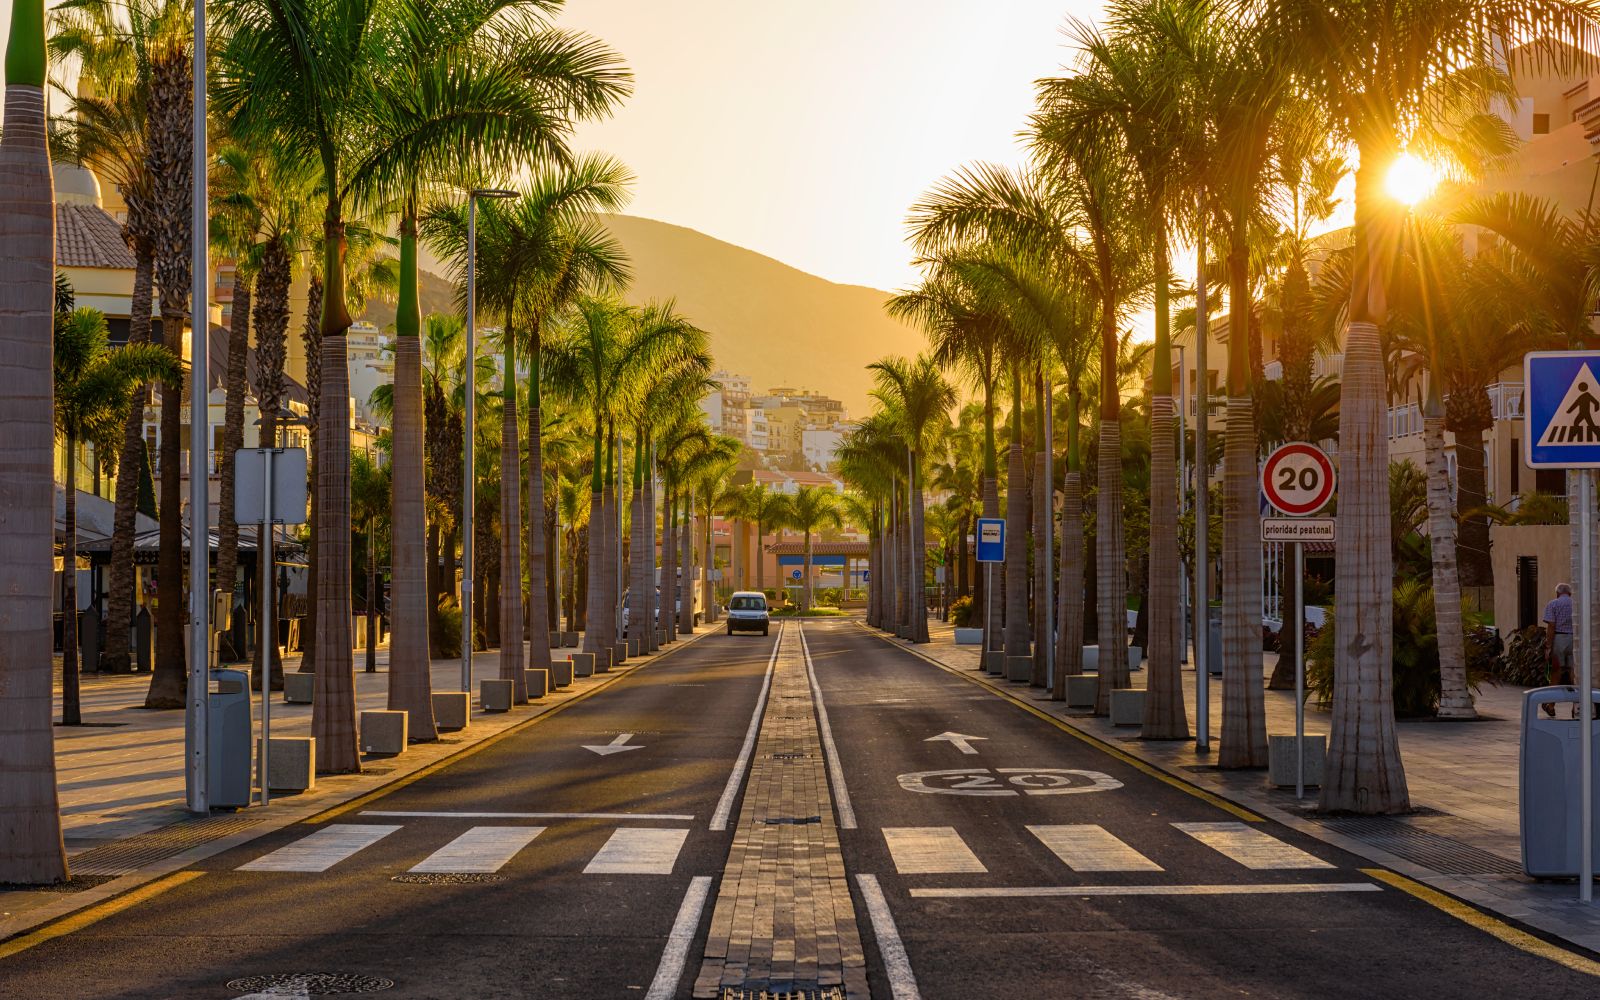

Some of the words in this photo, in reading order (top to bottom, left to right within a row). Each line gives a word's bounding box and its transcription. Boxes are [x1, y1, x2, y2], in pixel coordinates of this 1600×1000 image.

[1279, 467, 1318, 491] 20
[1265, 525, 1298, 536] prioridad
[1299, 525, 1332, 536] peatonal
[942, 774, 1071, 788] 20
